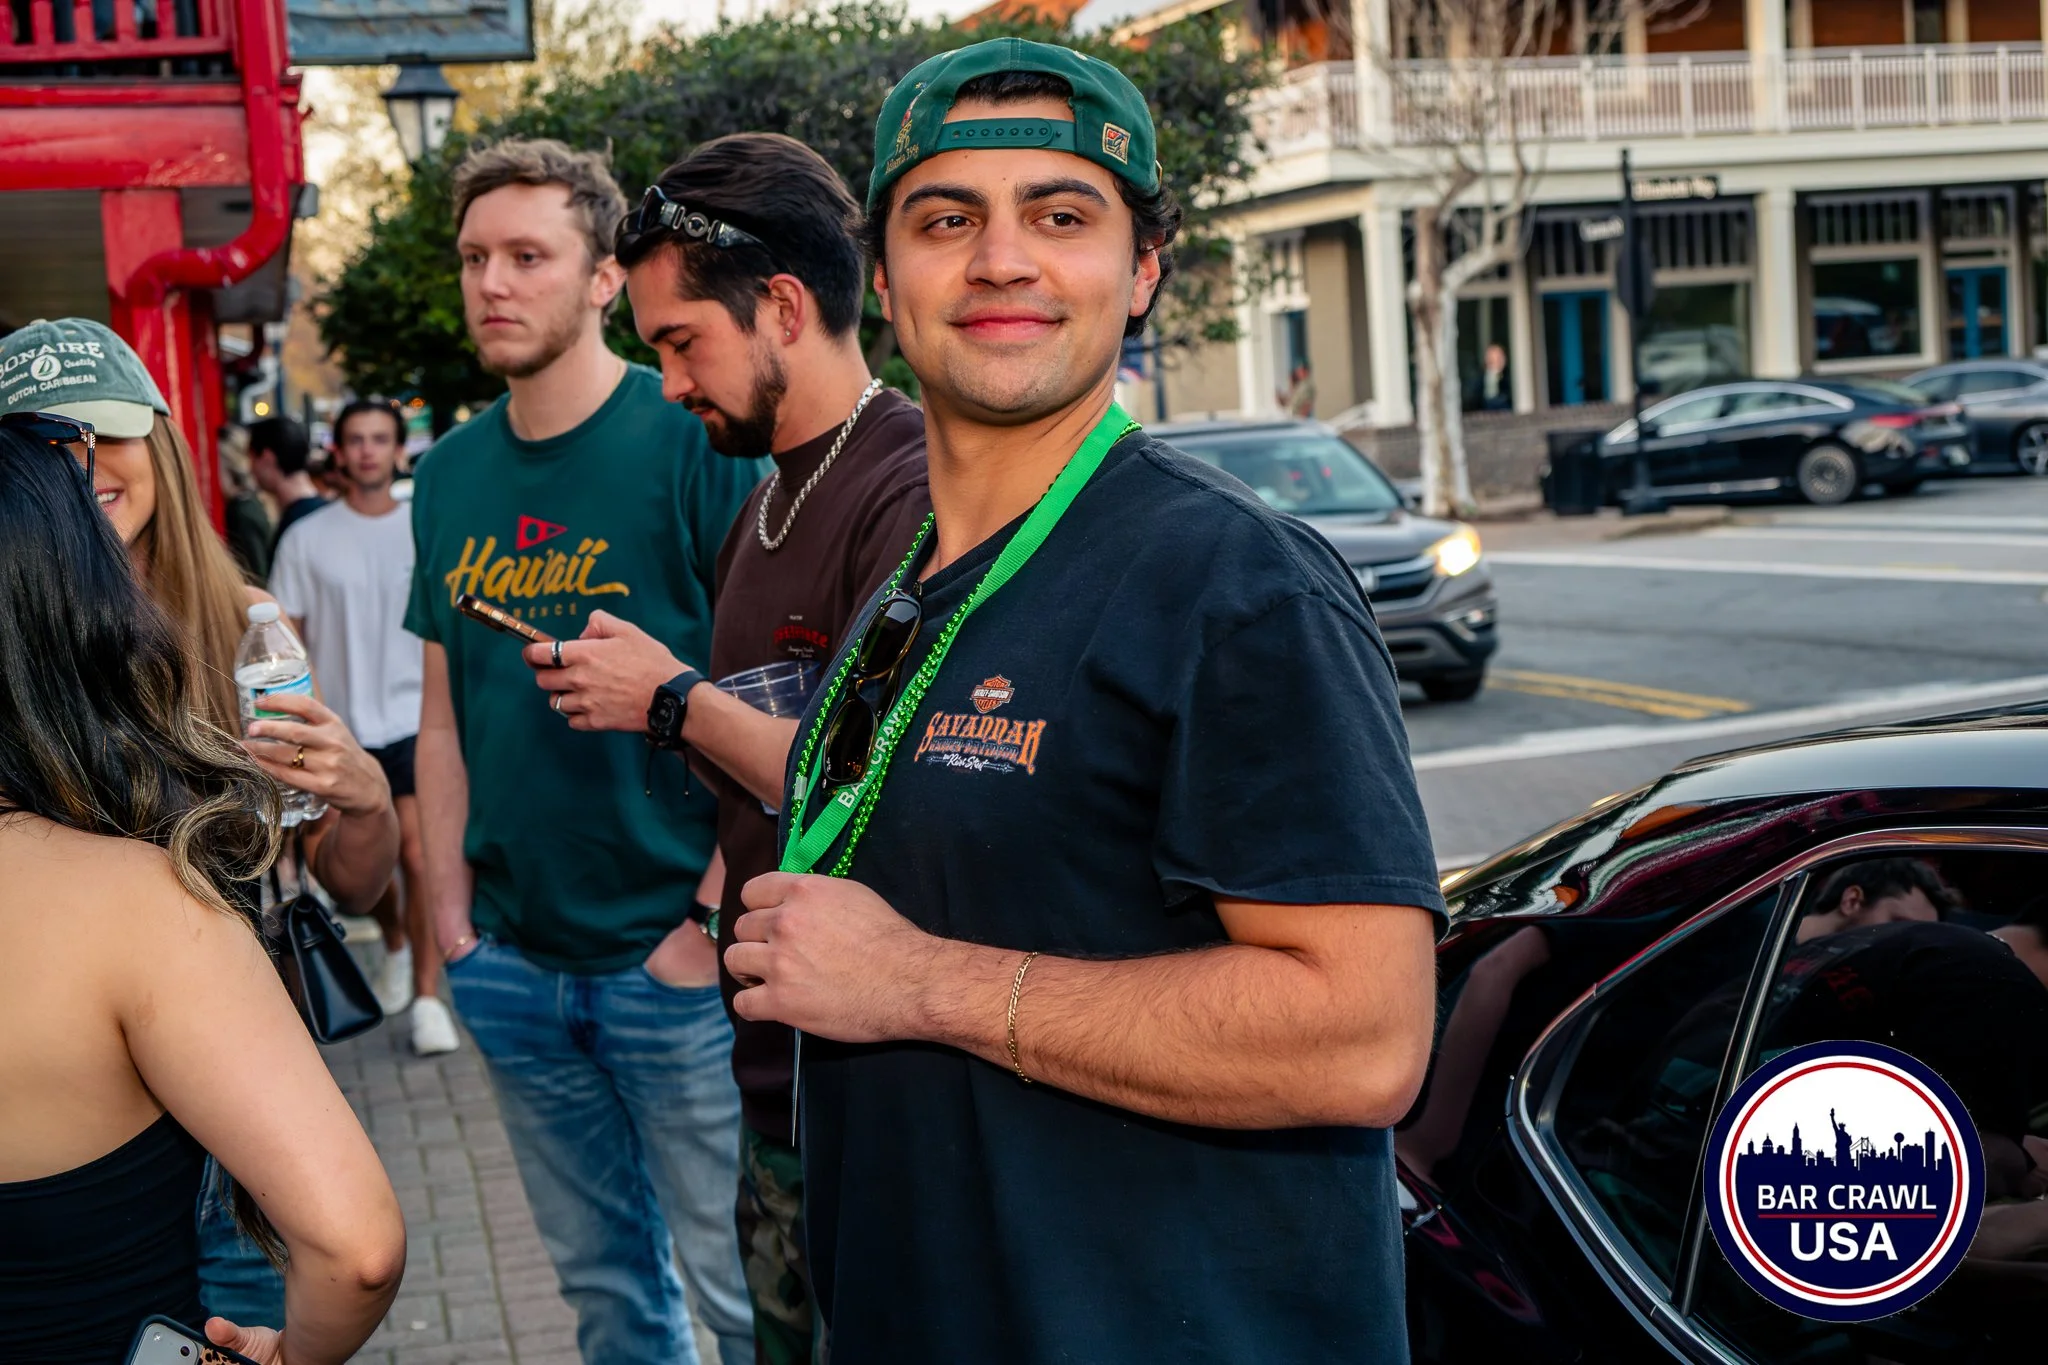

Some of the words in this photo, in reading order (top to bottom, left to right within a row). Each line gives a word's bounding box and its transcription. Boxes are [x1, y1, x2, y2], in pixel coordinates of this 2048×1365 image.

[7, 384, 38, 405] DUTCH
[39, 374, 98, 392] CARIBBEAN
[63, 358, 97, 369] Quality
[445, 536, 631, 608] Hawaii
[870, 703, 905, 766] CRAW
[914, 711, 1047, 776] SAVANNAH
